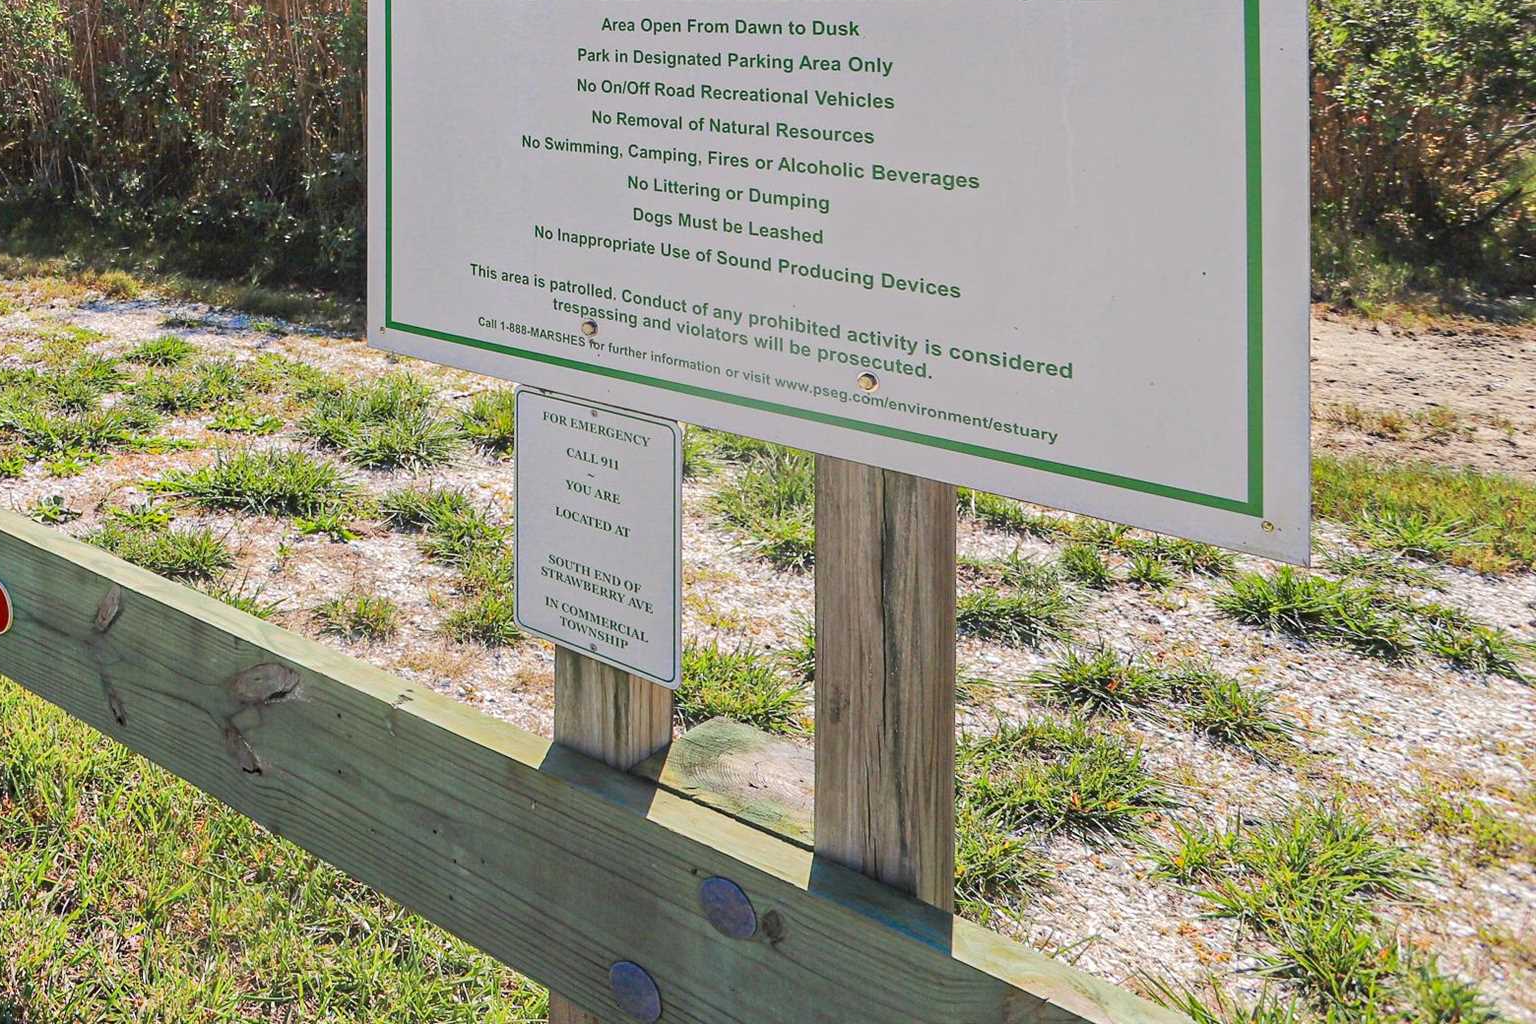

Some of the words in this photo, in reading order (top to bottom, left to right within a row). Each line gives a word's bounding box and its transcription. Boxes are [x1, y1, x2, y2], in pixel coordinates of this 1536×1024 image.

[601, 17, 635, 32] Area
[640, 18, 681, 36] Open
[687, 19, 729, 34] From
[735, 19, 782, 35] Dawn
[788, 21, 806, 35] to
[812, 20, 860, 36] Dusk
[578, 48, 610, 63] Park
[615, 49, 628, 63] in
[633, 49, 721, 69] Designated
[728, 53, 793, 73] Parking
[799, 55, 841, 71] Area
[848, 56, 893, 77] Only
[577, 78, 597, 92] No
[601, 80, 651, 96] On/Off
[654, 82, 695, 98] Road
[701, 84, 808, 104] Recreational
[814, 90, 895, 109] Vehicles
[592, 110, 612, 125] No
[616, 112, 682, 130] Removal
[688, 117, 705, 132] of
[709, 118, 769, 136] Natural
[776, 122, 874, 144] Resources
[522, 135, 541, 149] No
[544, 137, 623, 159] Swimming,
[628, 144, 702, 167] Camping,
[708, 150, 749, 168] Fires
[755, 158, 774, 170] or
[778, 157, 864, 179] Alcoholic
[872, 164, 980, 191] Beverages
[628, 175, 649, 191] No
[654, 178, 720, 202] Littering
[725, 189, 744, 200] or
[749, 188, 829, 214] Dumping
[633, 207, 673, 227] Dogs
[678, 212, 718, 231] Must
[723, 218, 743, 234] be
[749, 221, 823, 244] Leashed
[535, 225, 553, 240] No
[558, 228, 655, 255] Inappropriate
[661, 242, 690, 260] Use
[695, 249, 713, 263] of
[717, 250, 771, 272] Sound
[778, 258, 874, 290] Producing
[881, 272, 961, 298] Devices
[470, 263, 497, 280] This
[501, 272, 529, 286] area
[534, 274, 546, 288] is
[550, 280, 616, 301] patrolled.
[621, 289, 687, 313] Conduct
[692, 303, 709, 316] of
[713, 308, 742, 326] any
[749, 313, 840, 339] prohibited
[847, 330, 918, 356] activity
[925, 339, 942, 356] is
[949, 347, 1072, 379] considered
[553, 298, 638, 328] trespassing
[642, 317, 671, 331] and
[676, 321, 748, 345] violators
[754, 336, 783, 352] will
[790, 339, 811, 357] be
[818, 348, 932, 382] prosecuted.
[478, 316, 497, 329] Call
[500, 321, 585, 347] 1-888-MARSHES
[589, 338, 605, 351] for
[608, 342, 647, 360] further
[651, 351, 720, 375] information
[726, 369, 739, 378] or
[743, 370, 770, 385] visit
[775, 378, 1058, 445] www.pseg.com/environment/estuary
[543, 411, 567, 426] FOR
[570, 417, 651, 447] EMERGENCY
[566, 448, 599, 465] CALL
[601, 456, 618, 470] 911
[566, 480, 592, 496] YOU
[594, 489, 620, 504] ARE
[556, 506, 612, 532] LOCATED
[615, 525, 631, 538] AT
[541, 566, 626, 604] STRAWBERRY
[627, 597, 653, 614] AVE
[548, 554, 590, 577] SOUTH
[594, 569, 621, 587] END
[623, 580, 642, 593] OF
[546, 596, 559, 609] IN
[561, 602, 648, 643] COMMERCIAL
[560, 615, 628, 649] TOWNSHIP
